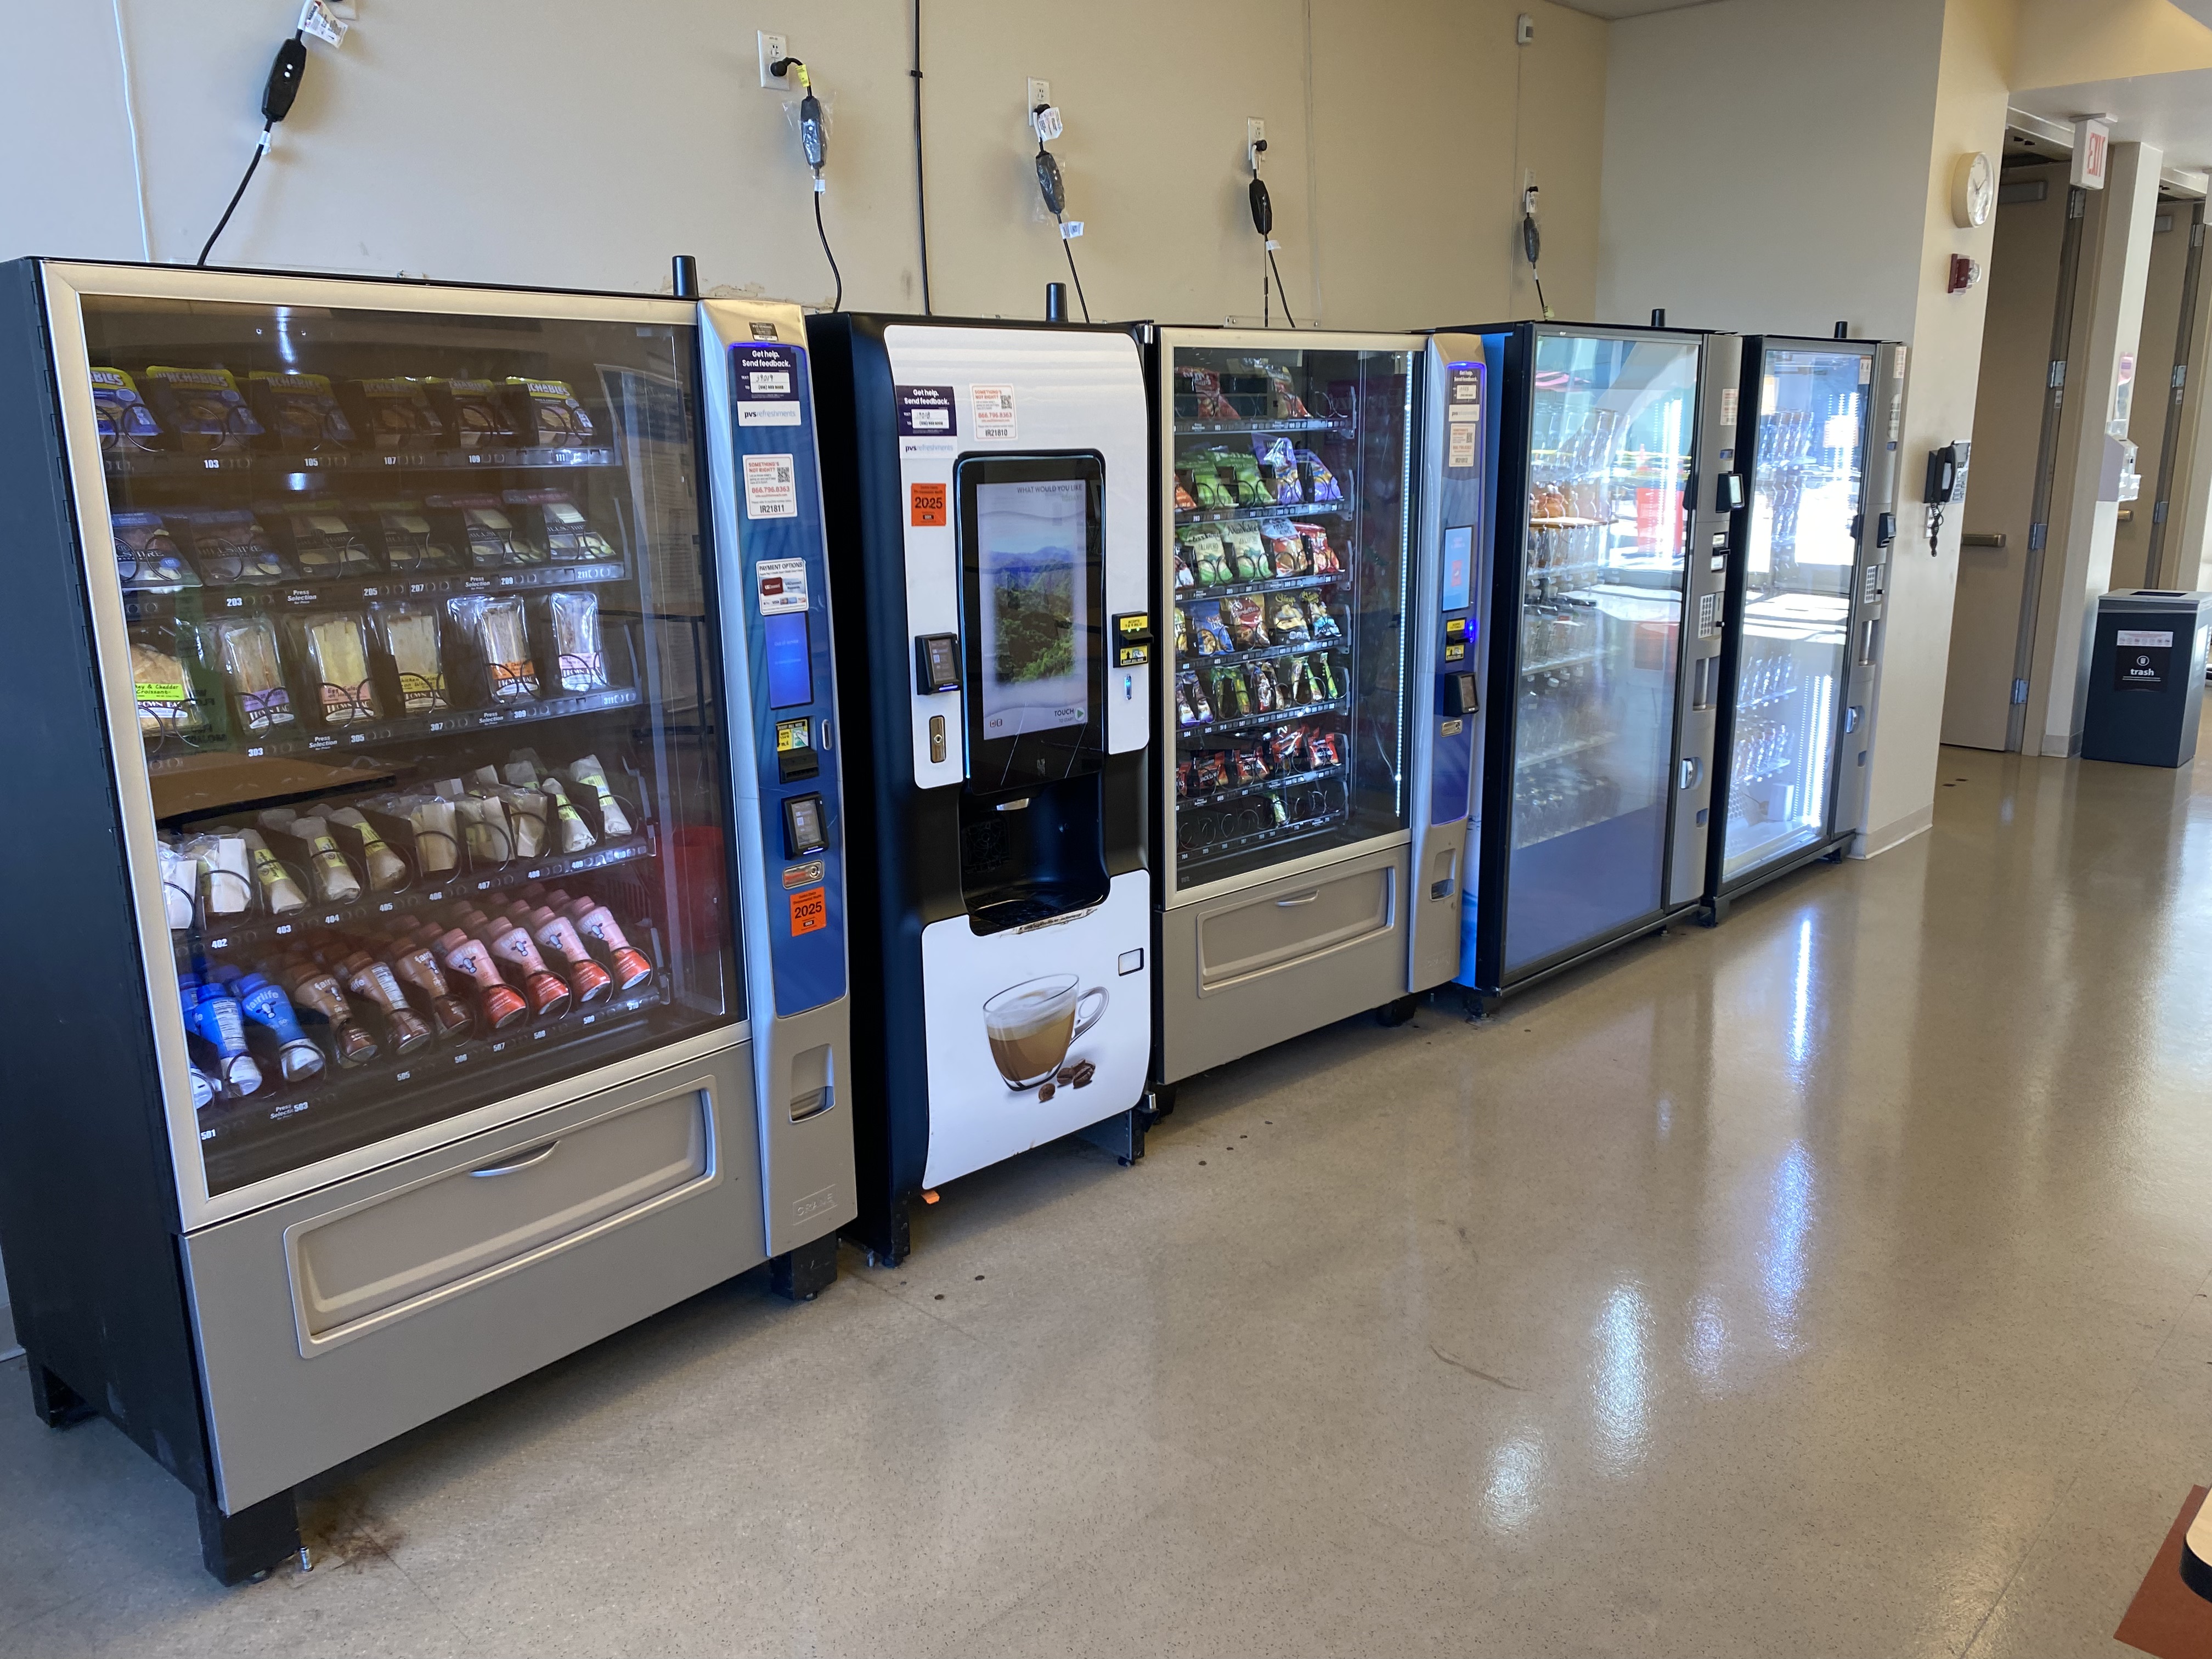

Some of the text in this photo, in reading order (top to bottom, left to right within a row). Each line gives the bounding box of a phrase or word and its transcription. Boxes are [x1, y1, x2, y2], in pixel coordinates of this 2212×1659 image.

[764, 351, 780, 359] help.
[924, 389, 939, 398] help.
[304, 458, 319, 468] 105
[384, 456, 397, 466] 107
[468, 454, 481, 464] 109
[555, 454, 566, 462] 111
[204, 459, 219, 469] 103
[915, 496, 943, 509] 2025
[760, 504, 785, 513] IR21811
[577, 569, 588, 579] 211
[500, 576, 514, 586] 209
[364, 587, 378, 596] 205
[411, 583, 424, 592] 207
[226, 597, 242, 607] 203
[603, 697, 614, 705] 311
[514, 709, 527, 719] 309
[1054, 708, 1074, 717] TOUCH
[478, 715, 504, 724] Selection
[430, 722, 444, 732] 307
[351, 733, 365, 743] 305
[309, 740, 338, 749] Selection
[247, 747, 264, 758] 303
[572, 860, 584, 868] 409
[528, 870, 540, 879] 408
[477, 881, 490, 890] 407
[429, 891, 442, 901] 406
[379, 902, 393, 912] 405
[794, 901, 822, 919] 2025
[325, 914, 340, 924] 404
[276, 925, 291, 934] 403
[211, 939, 228, 949] 402
[246, 990, 279, 1012] fairlife
[583, 1015, 595, 1025] 509
[534, 1030, 546, 1040] 508
[493, 1042, 505, 1052] 507
[397, 1071, 410, 1081] 505
[276, 1104, 292, 1112] Press
[294, 1102, 308, 1112] 503
[200, 1129, 216, 1140] 501
